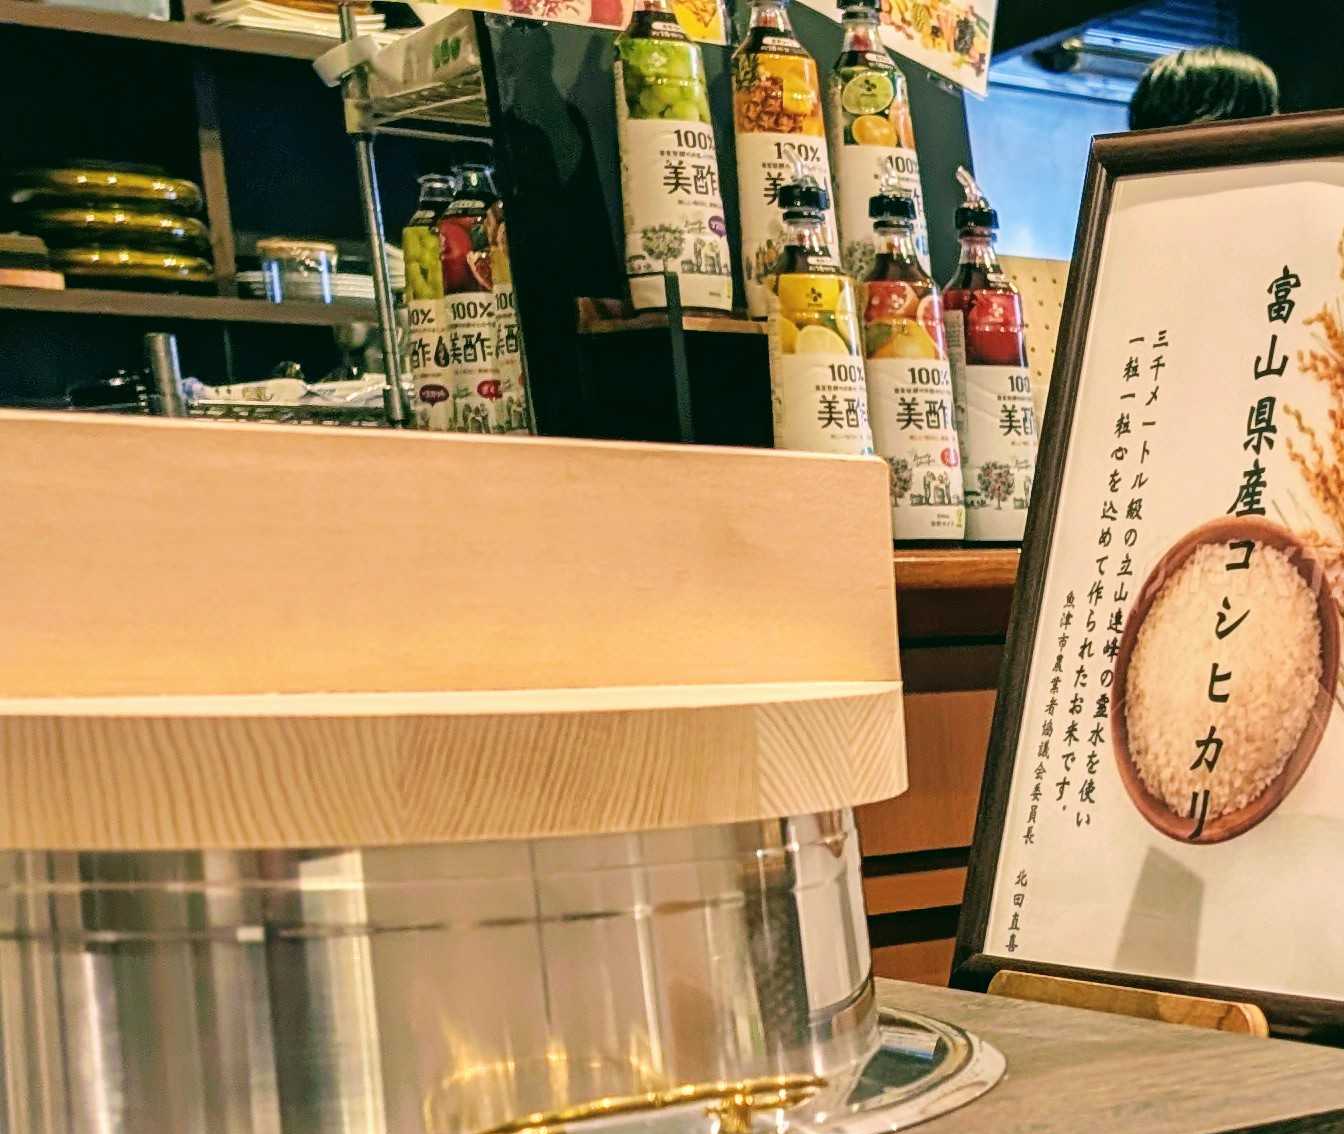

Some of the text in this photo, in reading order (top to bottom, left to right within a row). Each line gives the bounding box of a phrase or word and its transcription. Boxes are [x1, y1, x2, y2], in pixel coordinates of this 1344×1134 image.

[450, 301, 495, 320] 100%
[1189, 265, 1302, 840] 富山県産コシヒカリ
